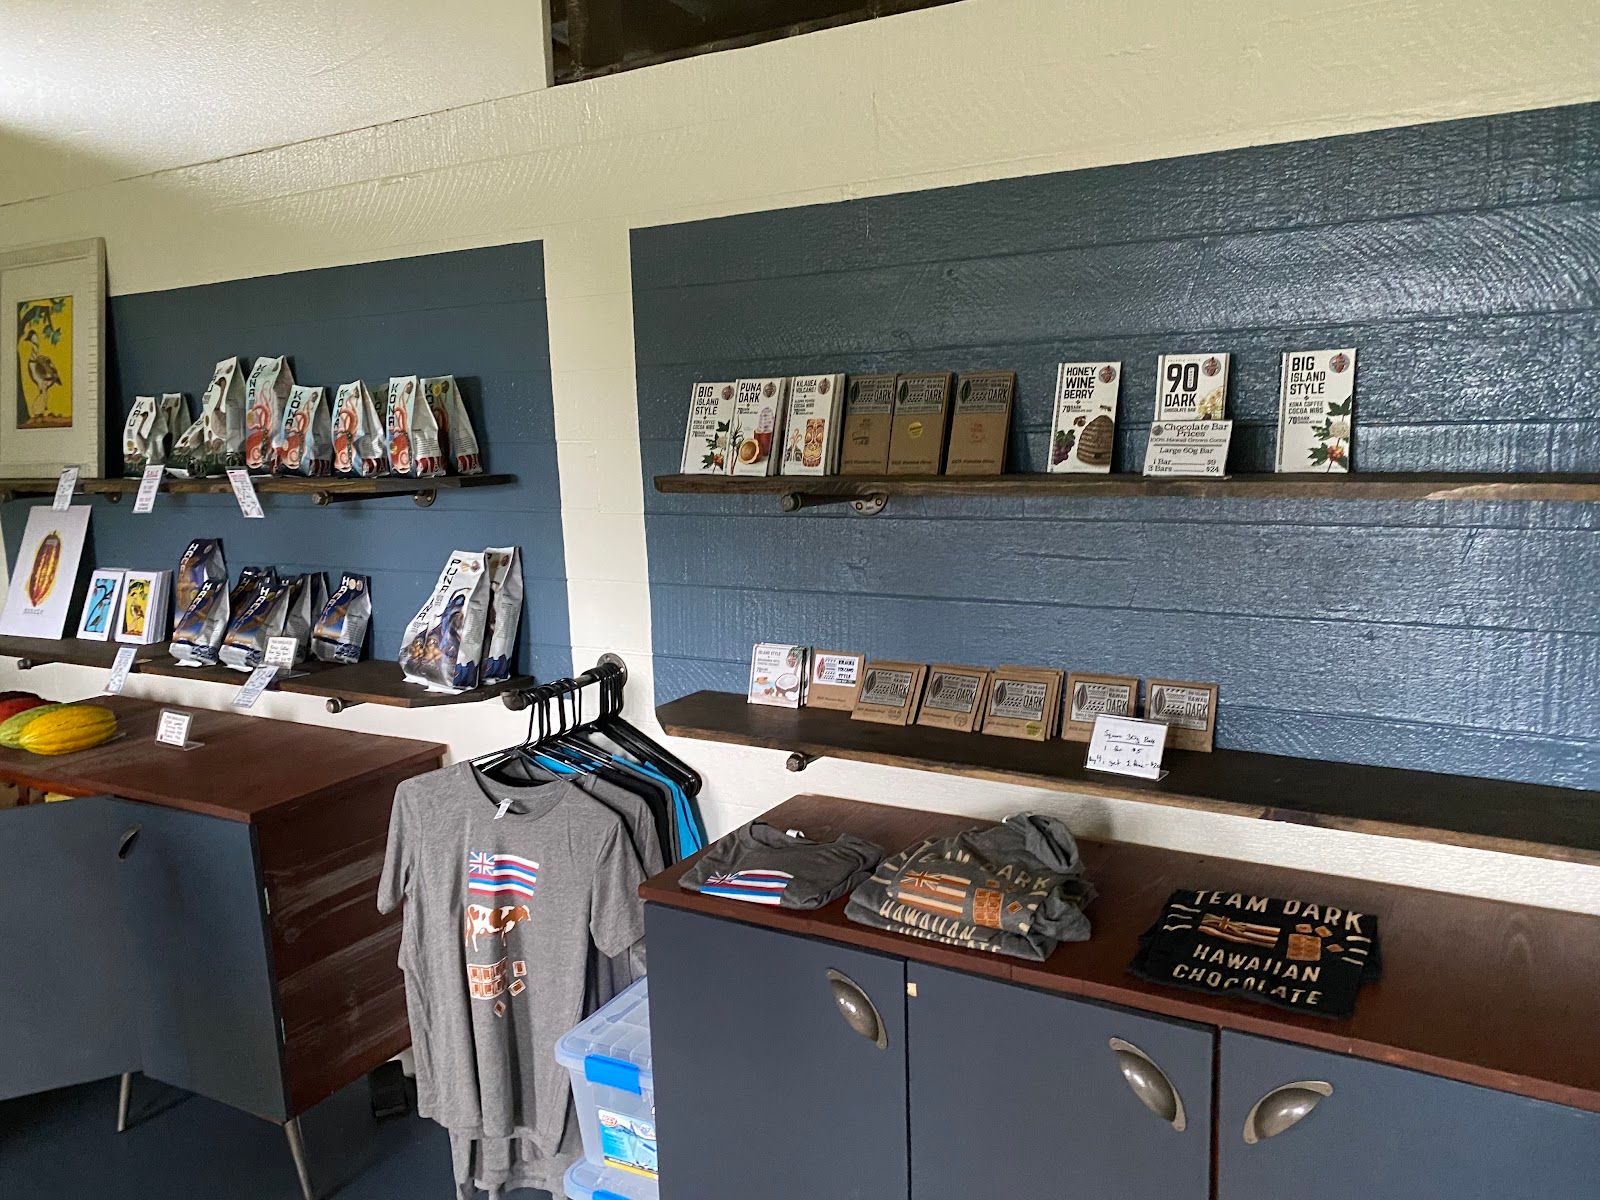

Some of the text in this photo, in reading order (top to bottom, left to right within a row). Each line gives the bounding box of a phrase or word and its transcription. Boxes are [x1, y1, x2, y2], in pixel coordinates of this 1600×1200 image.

[1291, 356, 1315, 371] BIG
[1066, 367, 1096, 376] HONEY
[1167, 363, 1199, 392] 90
[1290, 371, 1326, 382] ISLAND
[249, 364, 267, 397] KONA
[740, 383, 761, 391] PUNA
[1066, 377, 1095, 388] WINE
[698, 386, 713, 397] BIG
[924, 389, 943, 400] DARK
[987, 388, 1008, 400] DARK
[1063, 390, 1094, 399] BERRY
[1290, 383, 1325, 395] STYLE
[739, 393, 760, 402] DARK
[1165, 394, 1197, 407] DARK
[285, 390, 303, 427] KONA
[334, 389, 348, 428] KONA
[388, 383, 399, 426] KONA
[695, 407, 717, 415] STYLE
[1160, 447, 1181, 455] Large
[440, 559, 461, 594] PUNA
[1023, 695, 1044, 708] DARK
[1106, 699, 1127, 713] DARK
[1186, 703, 1208, 717] DARK
[1194, 890, 1363, 933] TEAM DARK
[879, 899, 976, 940] HAWAIIAN
[1193, 944, 1321, 982] HAWAIIAN
[1172, 964, 1323, 1005] CHOCOLATE
